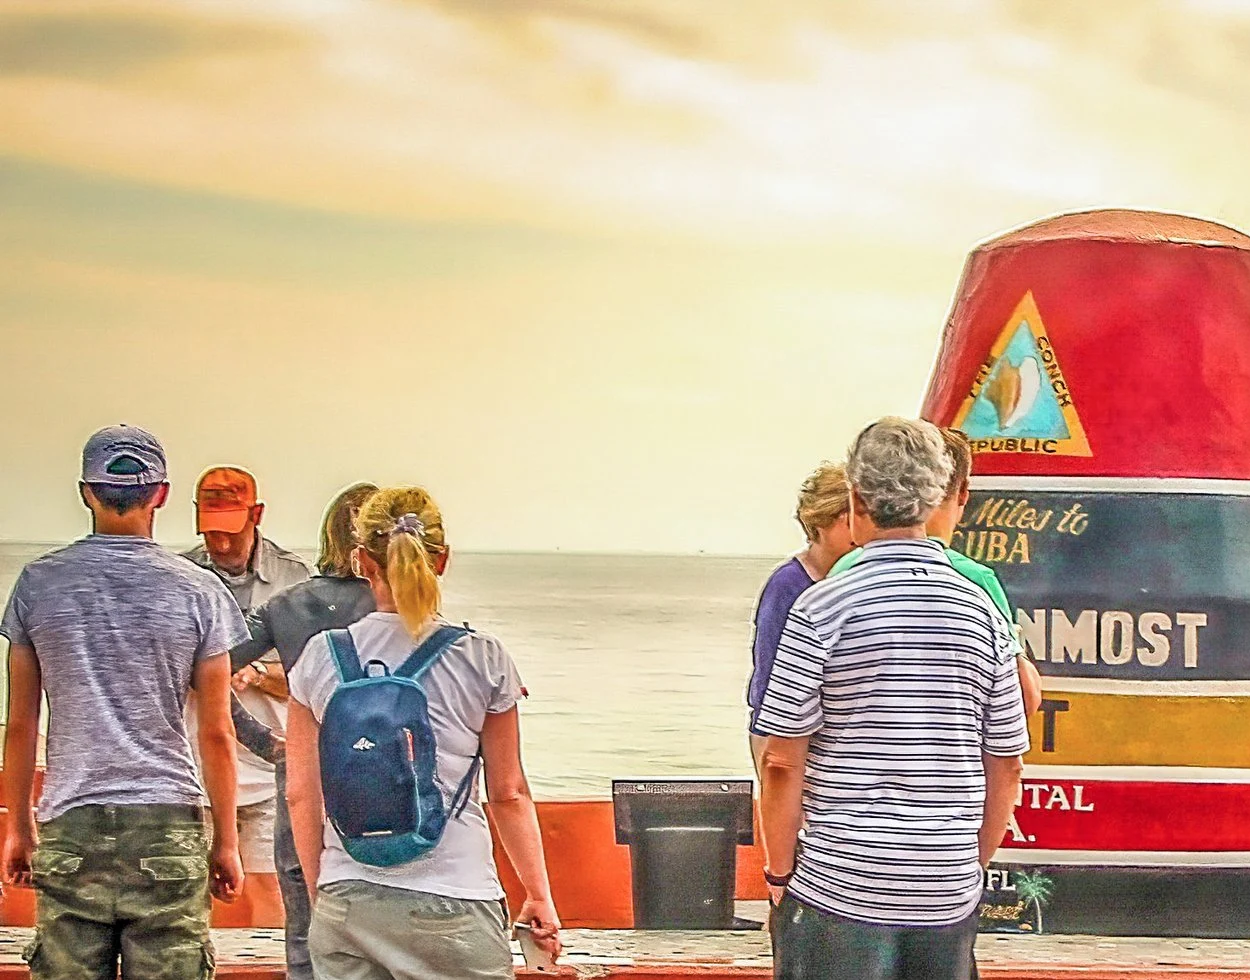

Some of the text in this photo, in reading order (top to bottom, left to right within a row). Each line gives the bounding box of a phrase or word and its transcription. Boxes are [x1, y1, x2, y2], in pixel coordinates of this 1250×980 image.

[1037, 336, 1071, 407] CONCH
[957, 497, 1089, 535] Miles to
[1016, 608, 1208, 667] NMOST
[1039, 699, 1069, 752] T
[986, 869, 1016, 891] FL
